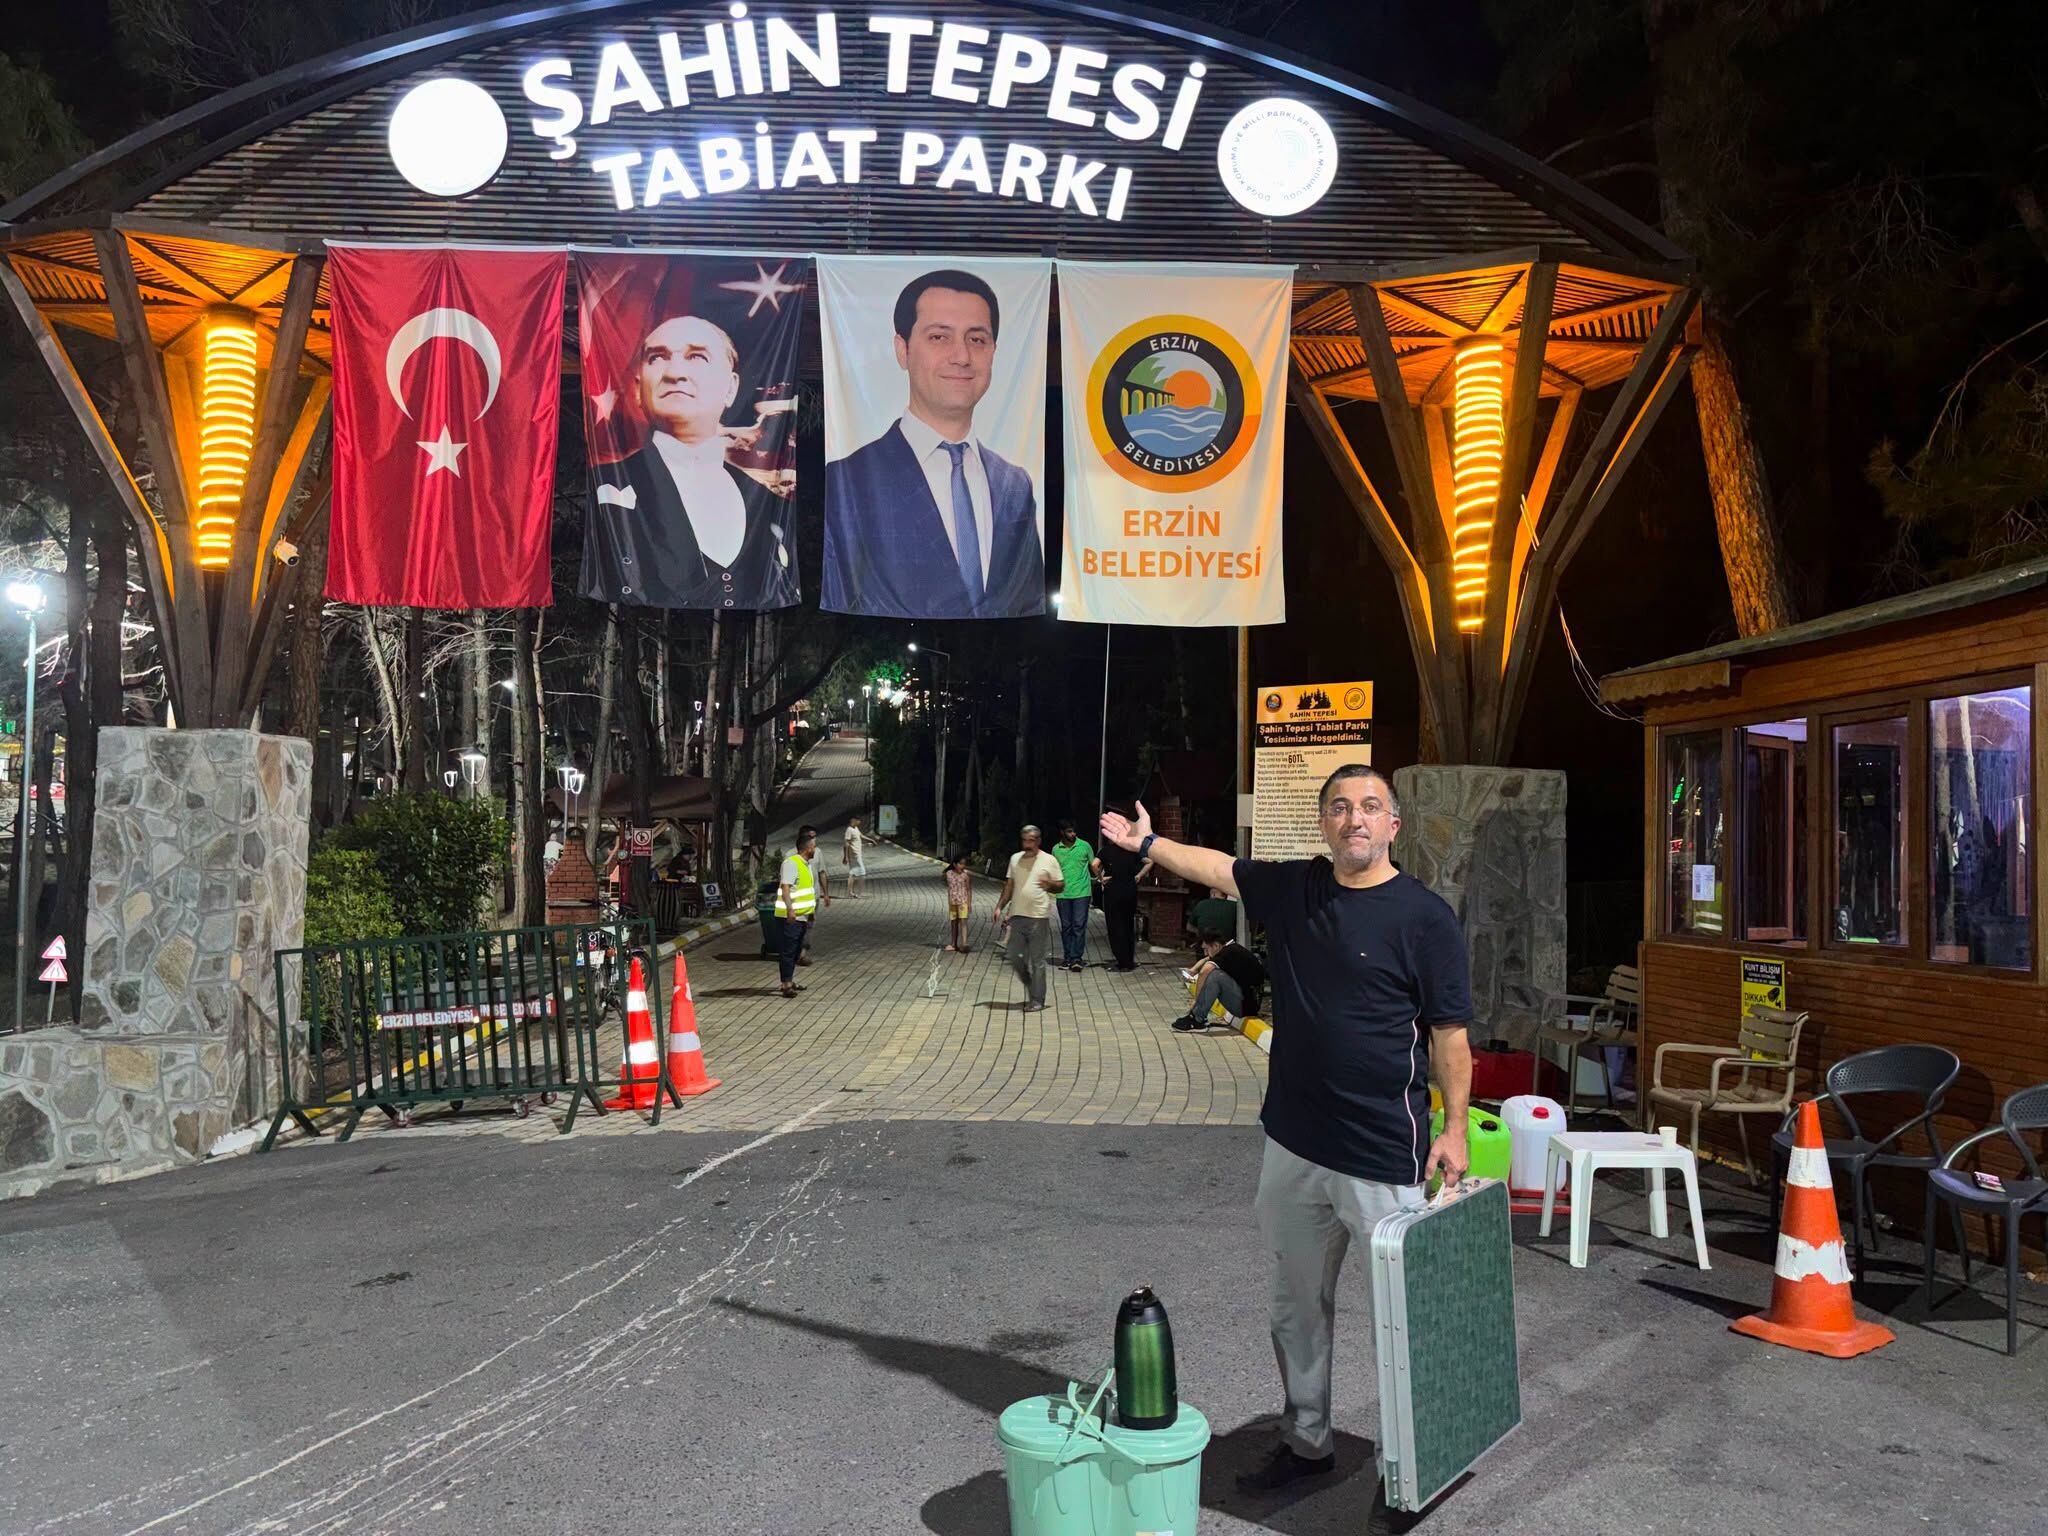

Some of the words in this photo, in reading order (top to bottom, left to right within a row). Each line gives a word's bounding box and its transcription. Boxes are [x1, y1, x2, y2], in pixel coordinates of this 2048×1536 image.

[522, 3, 841, 160] ŞAHİN
[868, 16, 1207, 151] TEPESİ
[592, 121, 877, 211] TABİAT
[900, 132, 1133, 222] PARKI
[1150, 335, 1199, 352] ERZİN
[1123, 442, 1221, 472] BELEDİYESİ
[1123, 505, 1221, 537] ERZİN
[1083, 545, 1261, 579] BELEDİYESİ
[1260, 725, 1283, 735] Şahin
[1285, 723, 1313, 733] Tepesi
[1315, 722, 1343, 731] Tabiat
[1346, 721, 1369, 730] Parkı
[1264, 735, 1308, 743] Tesisimize
[383, 1015, 414, 1028] ERZİN
[415, 1009, 474, 1026] BELEDİYESİ
